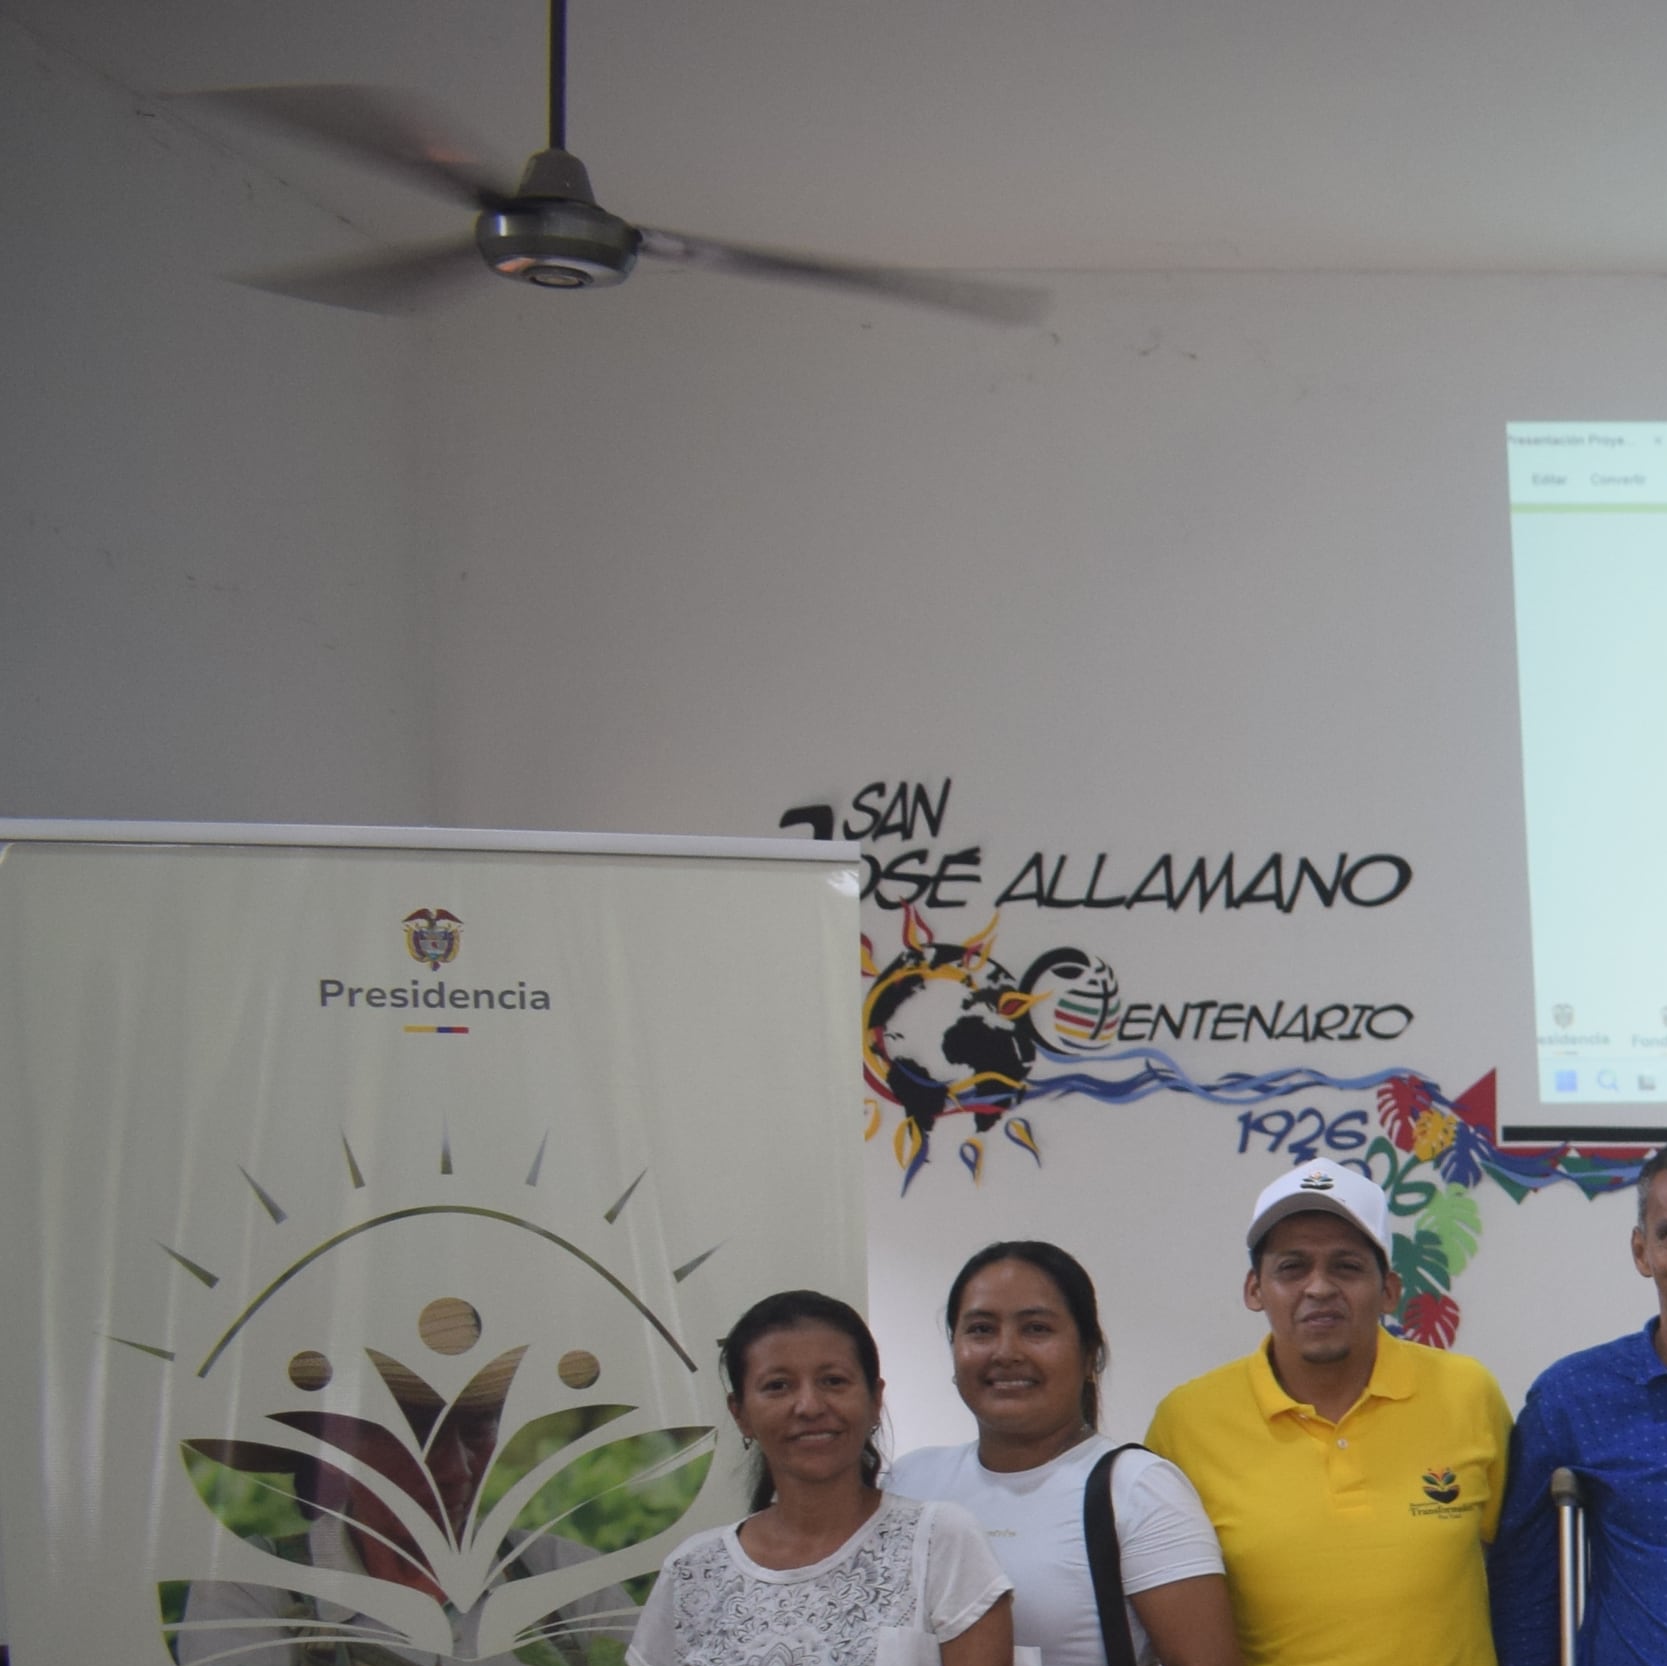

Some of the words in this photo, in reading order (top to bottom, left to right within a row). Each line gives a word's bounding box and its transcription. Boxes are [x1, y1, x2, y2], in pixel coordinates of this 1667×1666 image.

[1508, 433, 1584, 447] resentación
[842, 778, 952, 842] SAN
[995, 852, 1414, 914] ALLAMANO
[319, 979, 551, 1010] Presidencia
[1237, 1108, 1369, 1154] 1926
